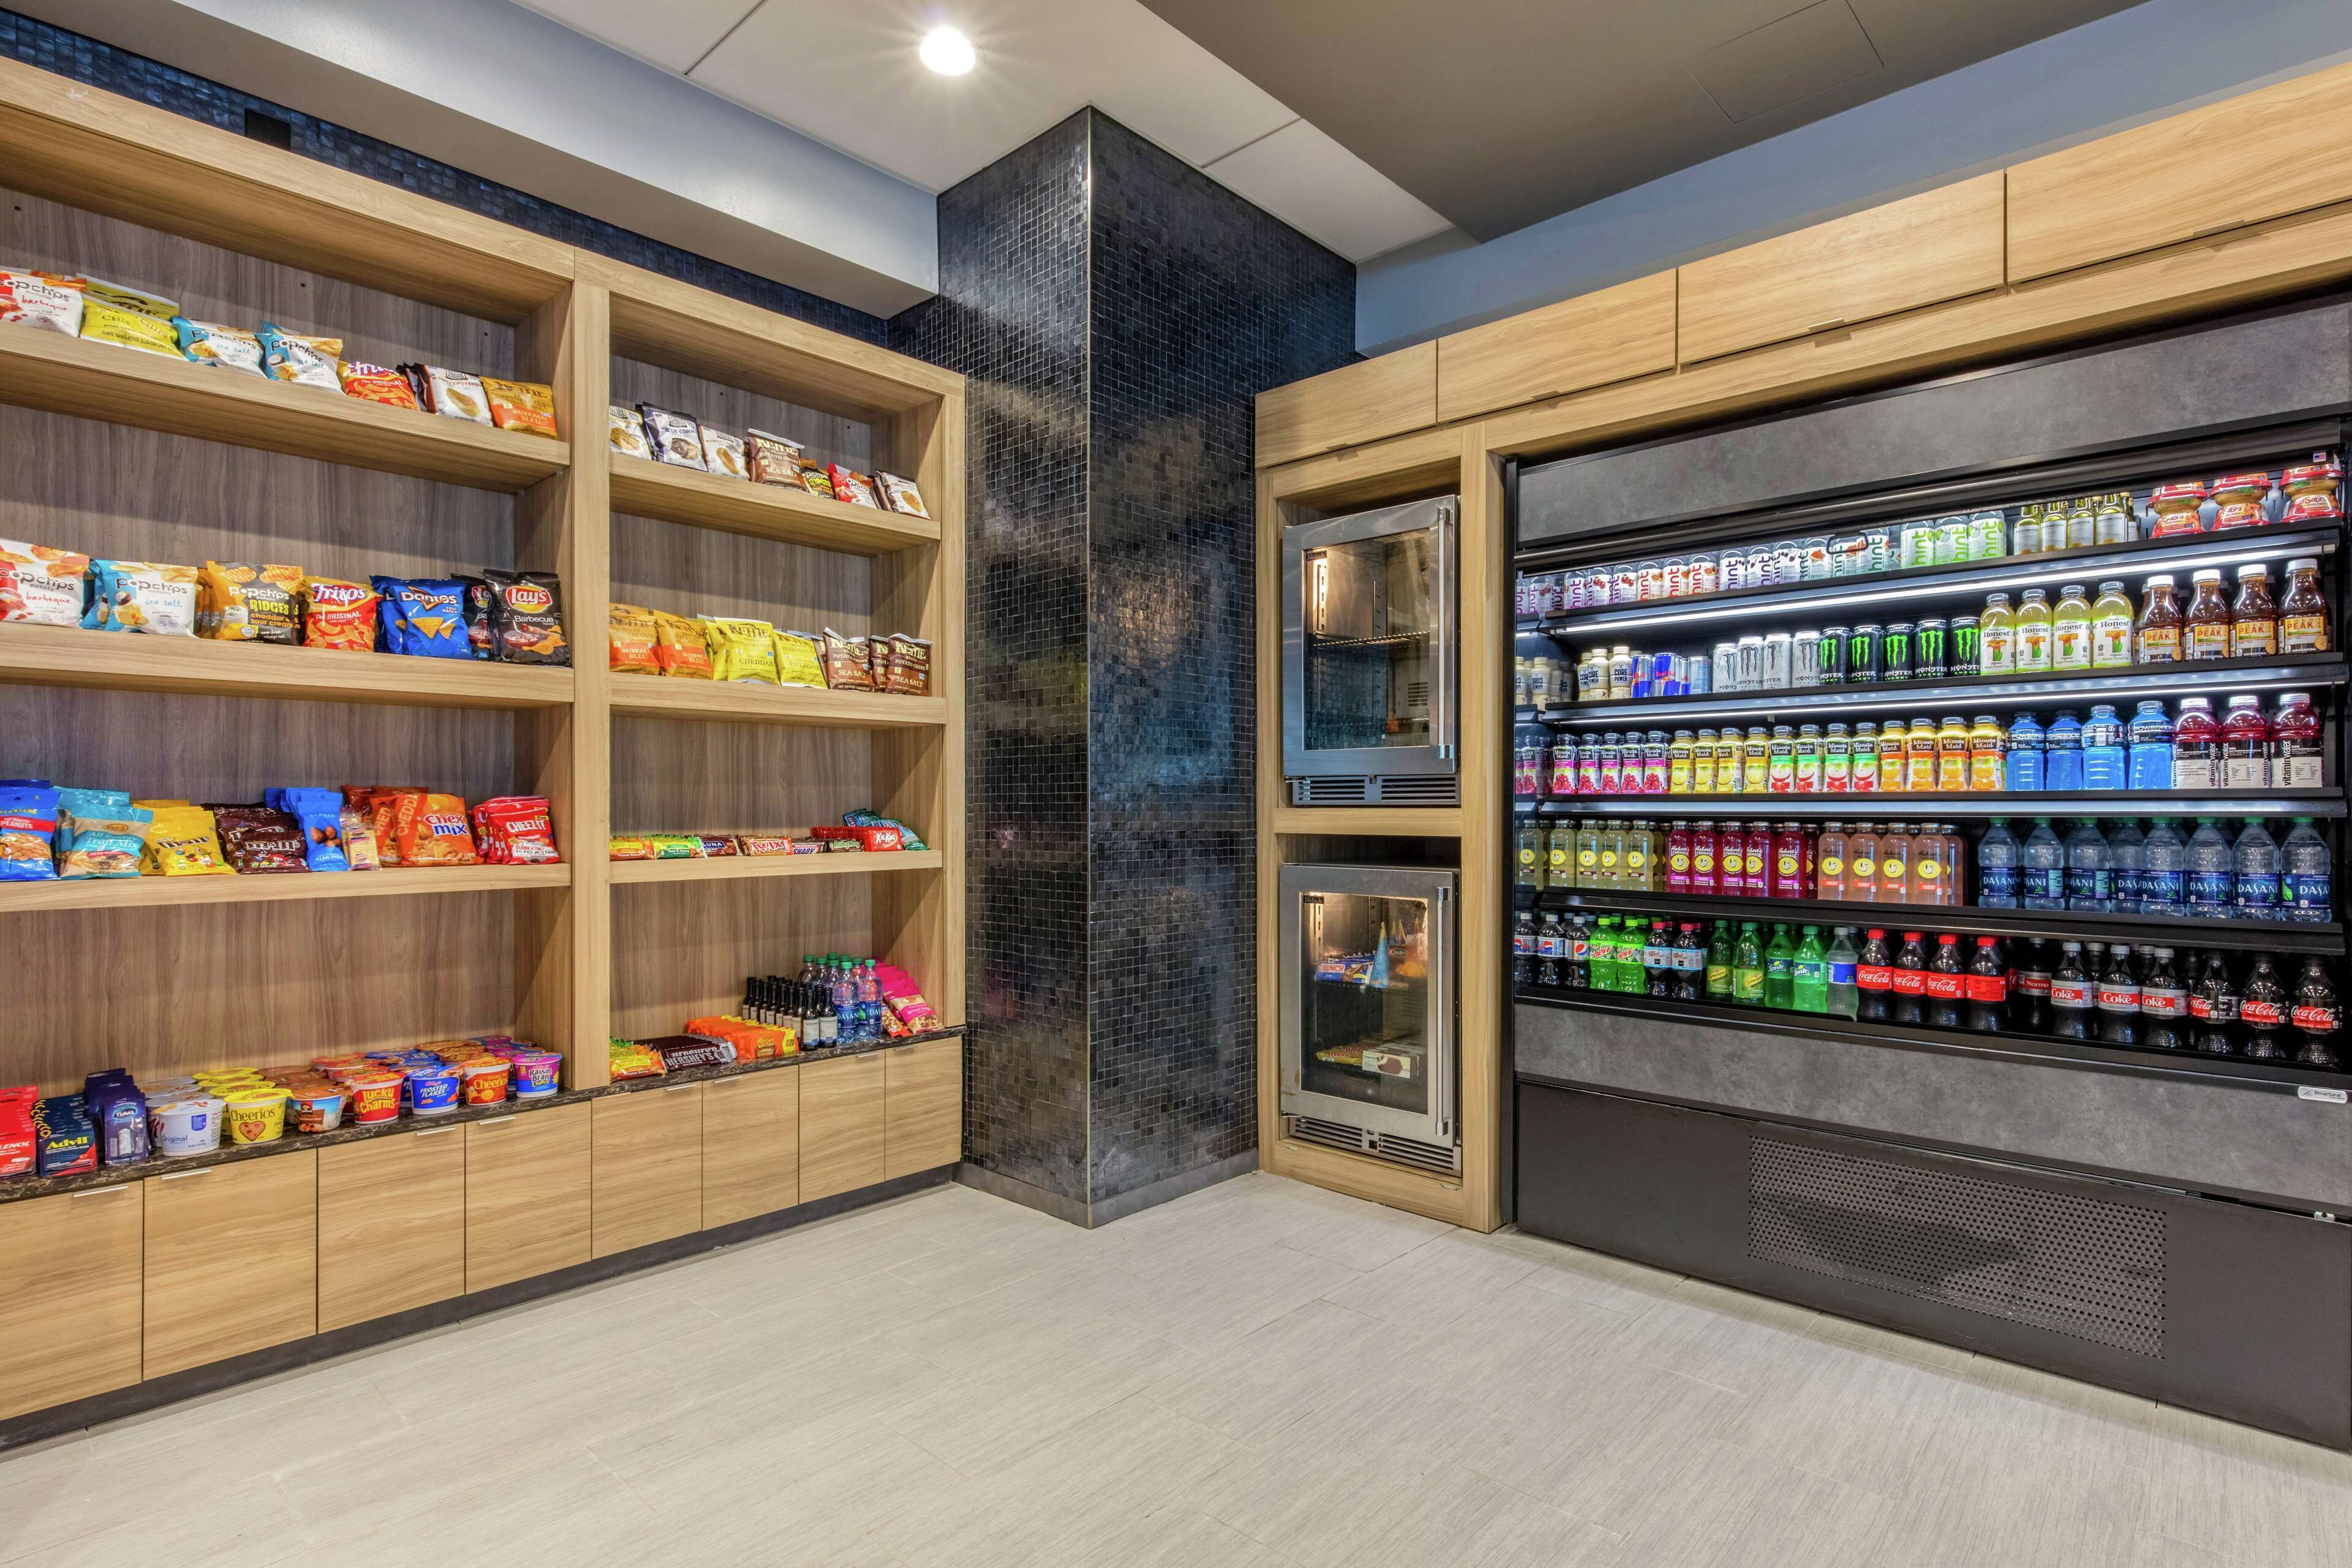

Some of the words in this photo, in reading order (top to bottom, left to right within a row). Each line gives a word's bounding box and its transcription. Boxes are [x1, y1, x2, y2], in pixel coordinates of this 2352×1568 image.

[1952, 524, 1966, 562] hint
[1981, 520, 1998, 559] hint
[1911, 529, 1927, 565] hint
[1869, 536, 1883, 572] hint
[1726, 559, 1739, 590] hint
[1758, 553, 1771, 586] hint
[116, 578, 187, 594] popchips
[1638, 570, 1649, 601] hint
[1667, 567, 1680, 598] hint
[1690, 564, 1702, 595] hint
[29, 583, 55, 592] potato
[228, 586, 290, 600] popchips
[310, 582, 367, 603] Fritos
[26, 591, 70, 605] barbeque
[511, 587, 548, 605] Lay's
[164, 598, 182, 608] salt
[249, 599, 289, 615] RIDGES
[251, 612, 285, 621] cheddar
[327, 611, 362, 619] ORIGINAL
[2055, 624, 2082, 632] Honest
[739, 658, 774, 668] CHEDDAR
[910, 677, 923, 687] SALT
[0, 820, 33, 829] PEANUTS
[423, 813, 465, 825] Chex
[432, 823, 469, 835] mix
[752, 839, 785, 854] TWIX
[1983, 876, 2015, 886] DASANI
[2065, 876, 2093, 887] DASANI
[2118, 878, 2142, 889] DASA
[2143, 880, 2179, 892] DASANI
[2190, 880, 2228, 892] DASANI
[2238, 882, 2278, 895] DASANI
[2299, 883, 2329, 896] DASA
[1858, 970, 1890, 984] Coca-Cola
[2052, 988, 2075, 999] Coke
[2103, 993, 2132, 1004] Coke
[2142, 996, 2166, 1007] Coke
[2240, 1000, 2282, 1016] Coca-Cola
[2291, 1005, 2336, 1022] Coca-Cola
[666, 1052, 715, 1067] HERSHEY'S
[529, 1068, 552, 1076] Raisin
[420, 1084, 448, 1093] FROSTED
[473, 1078, 508, 1089] Cheerios
[363, 1087, 394, 1103] Lucky
[421, 1089, 445, 1098] FLAKES
[359, 1098, 395, 1114] Charms
[231, 1108, 275, 1121] Cheerios
[47, 1136, 89, 1149] Advil
[162, 1135, 188, 1144] Original
